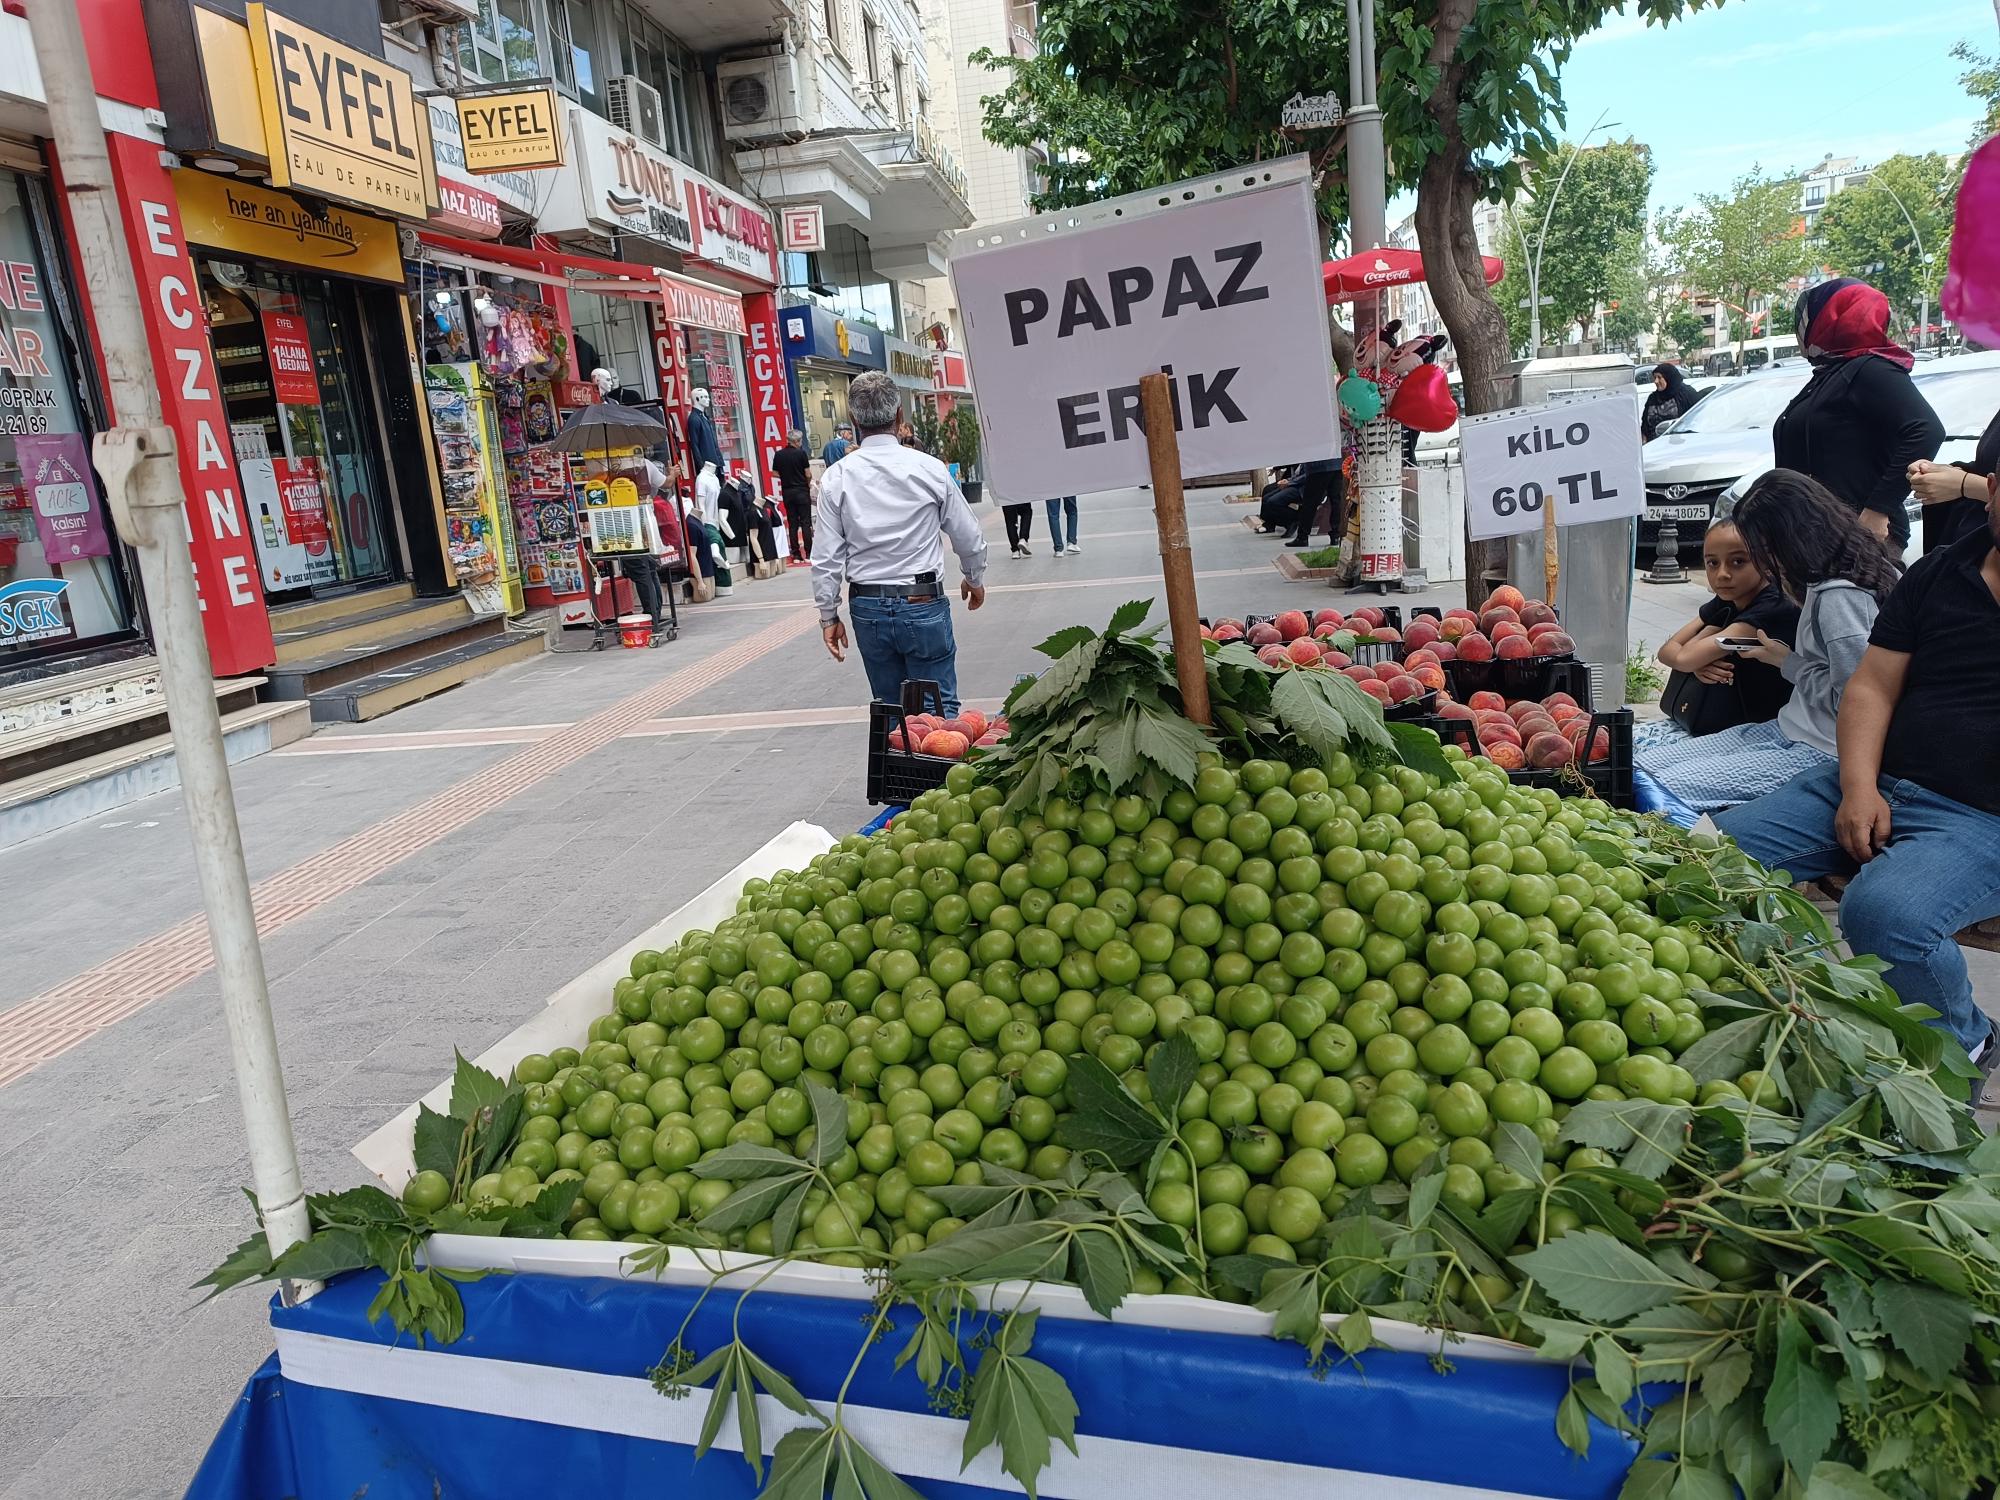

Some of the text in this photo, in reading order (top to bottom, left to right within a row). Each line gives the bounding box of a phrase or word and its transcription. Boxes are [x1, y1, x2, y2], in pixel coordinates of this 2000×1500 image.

[275, 29, 416, 160] EYFEL
[464, 103, 548, 141] EYFEL
[469, 150, 488, 159] EAU
[512, 145, 551, 154] PARFUM
[293, 153, 422, 204] EAU DE PARFUM
[608, 136, 683, 212] TÜNEL
[226, 188, 353, 242] her an yanında
[441, 187, 500, 225] MAZ BÜFE
[698, 184, 770, 254] ECZANE
[668, 287, 742, 331] YILMAZ BÜFE
[1004, 241, 1270, 347] PAPAZ
[276, 318, 294, 329] EYFEL
[280, 346, 308, 360] ALANA
[281, 359, 310, 372] BEDAVA
[140, 200, 256, 607] ECZANE
[1057, 364, 1248, 450] ERİK
[6, 414, 49, 435] 21 89
[1507, 422, 1590, 458] KİLO
[1492, 470, 1618, 517] 60 TL
[51, 514, 87, 531] kalsın!
[0, 597, 63, 635] SGK
